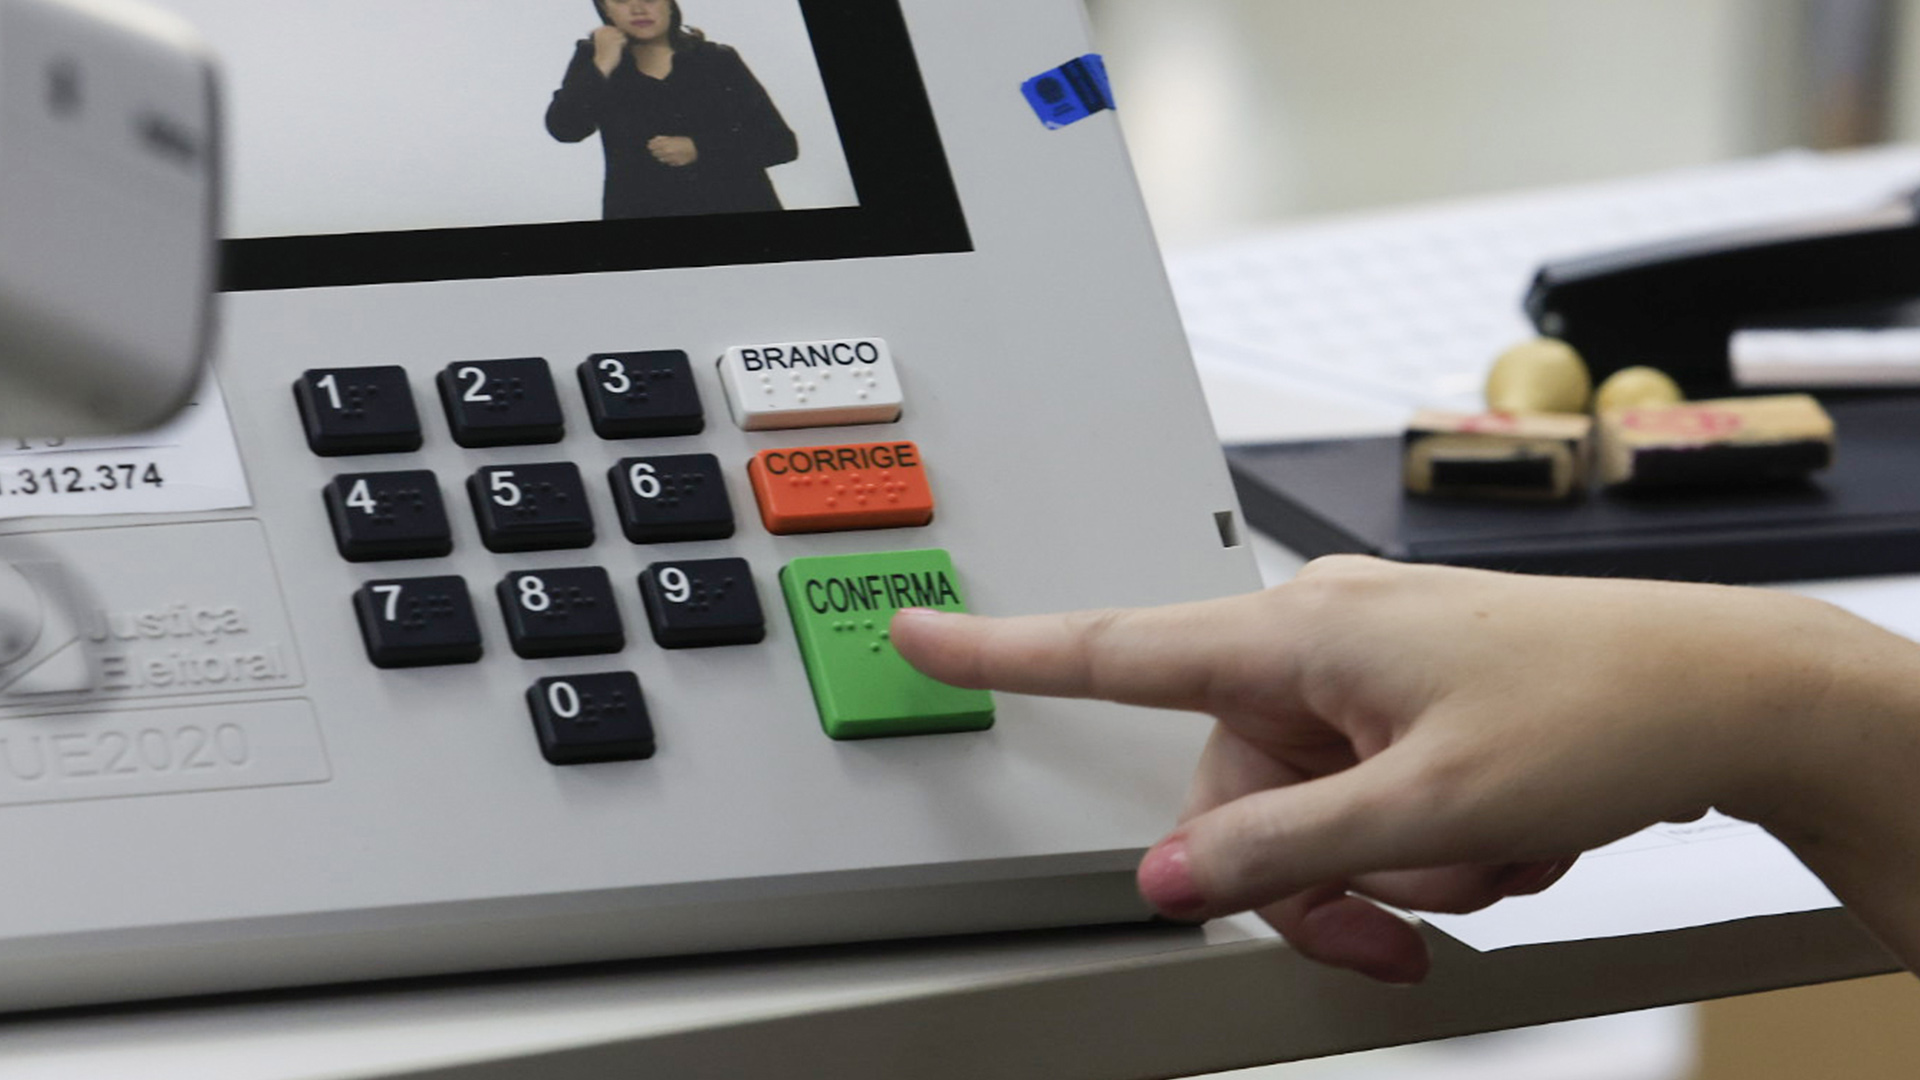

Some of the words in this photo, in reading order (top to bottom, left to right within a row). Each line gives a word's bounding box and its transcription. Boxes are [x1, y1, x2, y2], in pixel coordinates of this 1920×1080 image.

[741, 341, 879, 371] BRANCO
[317, 375, 342, 409] 1
[457, 367, 492, 402] 2
[598, 359, 631, 394] 3
[765, 445, 917, 475] CORRIGE
[346, 480, 377, 514] 4
[490, 471, 522, 507] 5
[629, 463, 661, 498] 6
[372, 585, 402, 621] 7
[518, 576, 550, 612] 8
[659, 568, 691, 603] 9
[805, 571, 961, 614] CONFIRMA
[101, 644, 288, 691] Eleitoral
[548, 682, 580, 718] 0
[0, 723, 250, 782] UE2020
